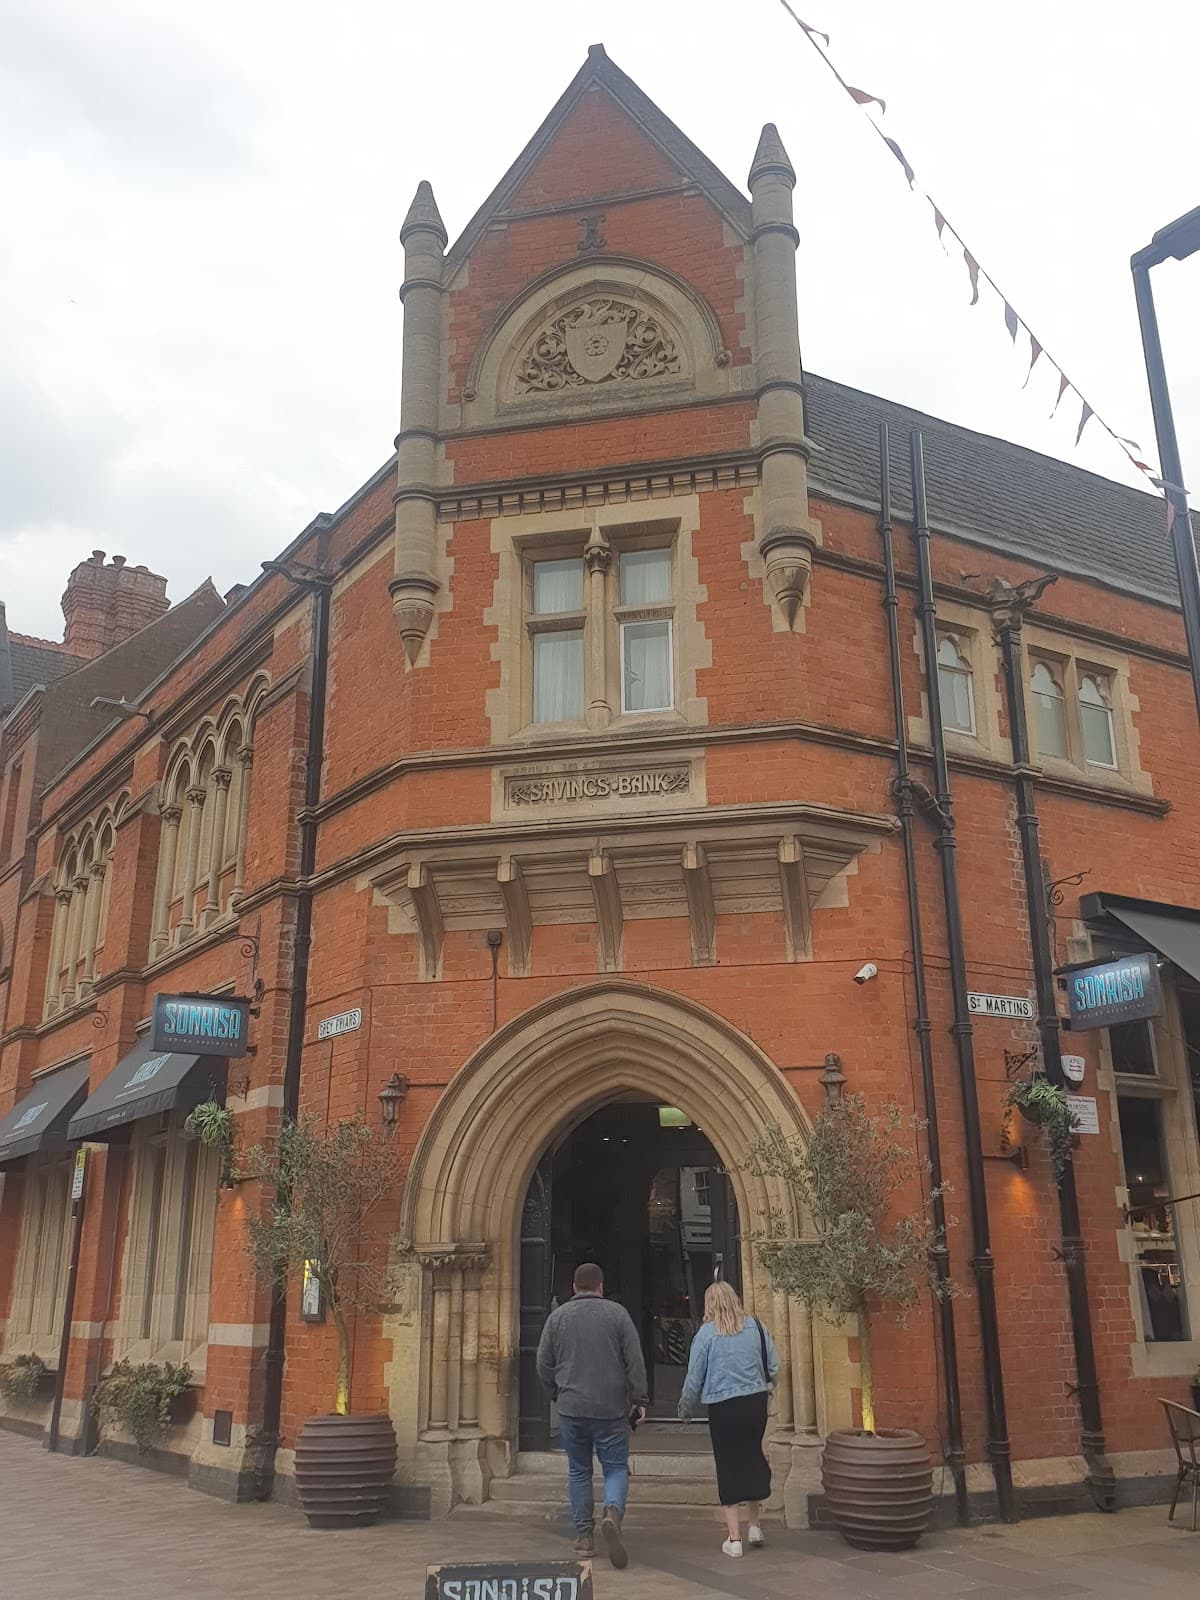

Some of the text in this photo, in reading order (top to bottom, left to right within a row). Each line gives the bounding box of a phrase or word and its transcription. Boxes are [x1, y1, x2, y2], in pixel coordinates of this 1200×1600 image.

[618, 772, 668, 796] BANK
[1074, 966, 1144, 1011] SONRISA
[986, 998, 1029, 1015] MARTINS
[164, 1003, 241, 1039] SONRISA
[336, 1012, 358, 1031] FRIARS
